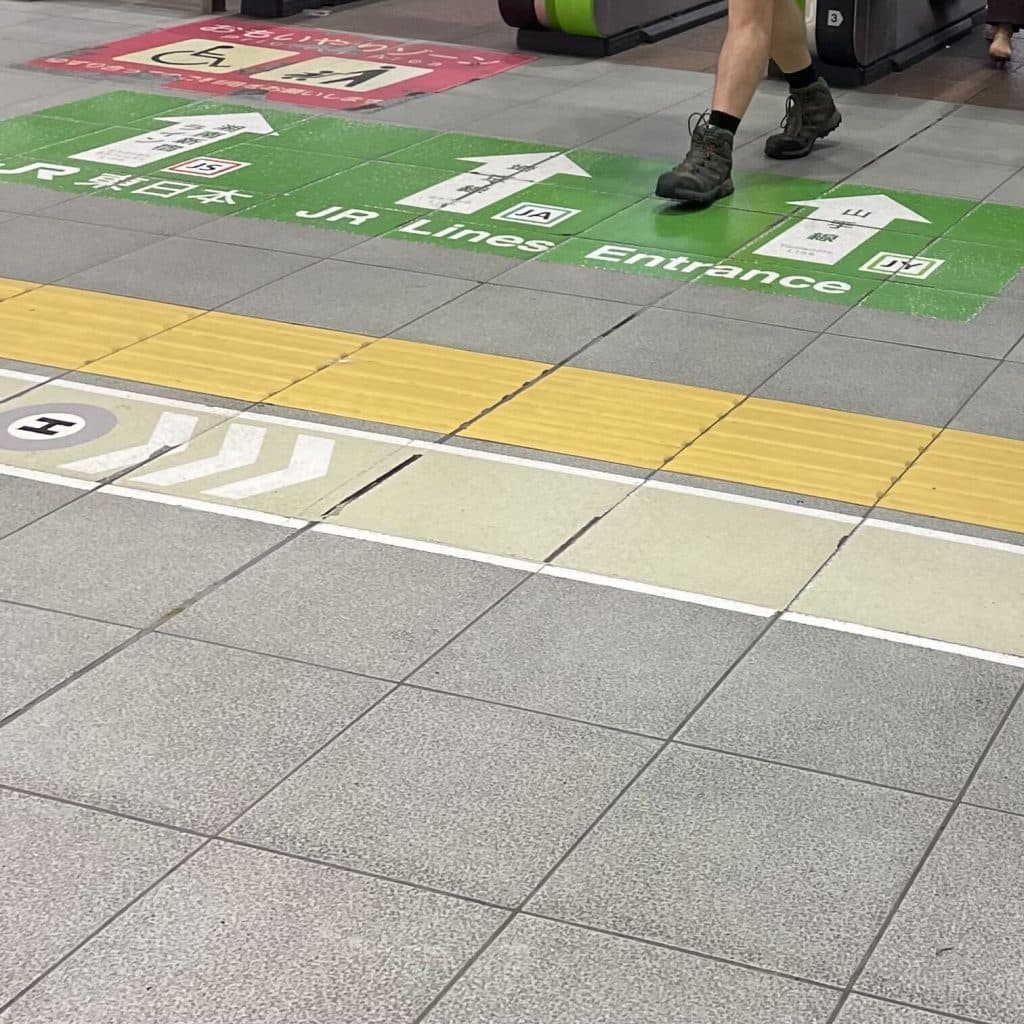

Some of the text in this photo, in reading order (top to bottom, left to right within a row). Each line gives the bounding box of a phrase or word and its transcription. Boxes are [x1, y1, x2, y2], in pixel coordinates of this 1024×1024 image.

[831, 13, 838, 23] 3
[186, 162, 223, 172] JS
[515, 209, 552, 220] JA
[295, 205, 852, 295] JR Lines Entrance
[880, 259, 923, 270] JY
[17, 416, 77, 436] H
